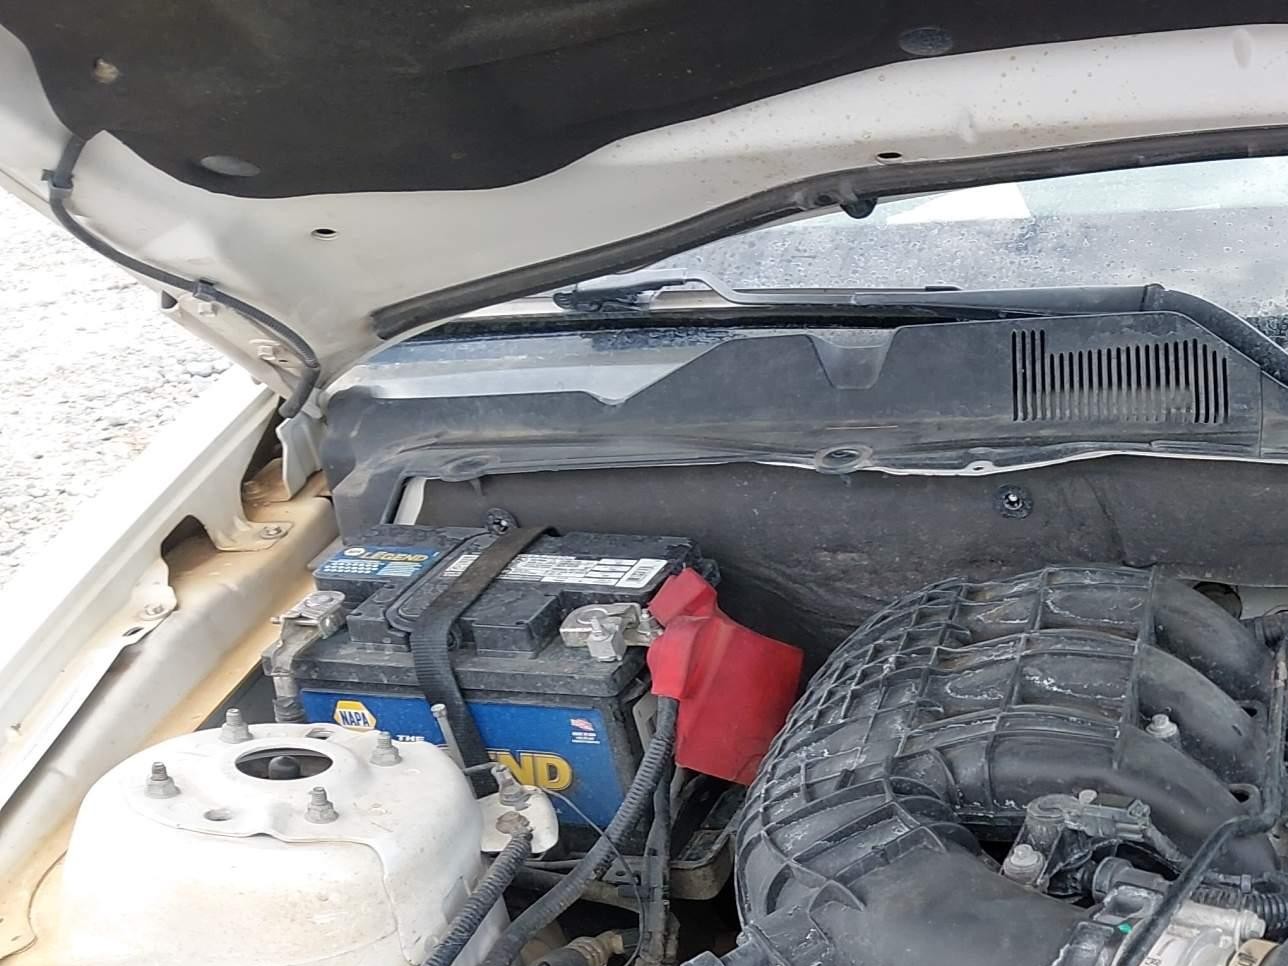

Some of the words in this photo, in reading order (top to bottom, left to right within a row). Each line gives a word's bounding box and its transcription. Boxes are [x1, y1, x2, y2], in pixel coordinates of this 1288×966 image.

[360, 551, 429, 562] LEGEND
[339, 710, 371, 727] NAPA
[396, 734, 425, 743] THE
